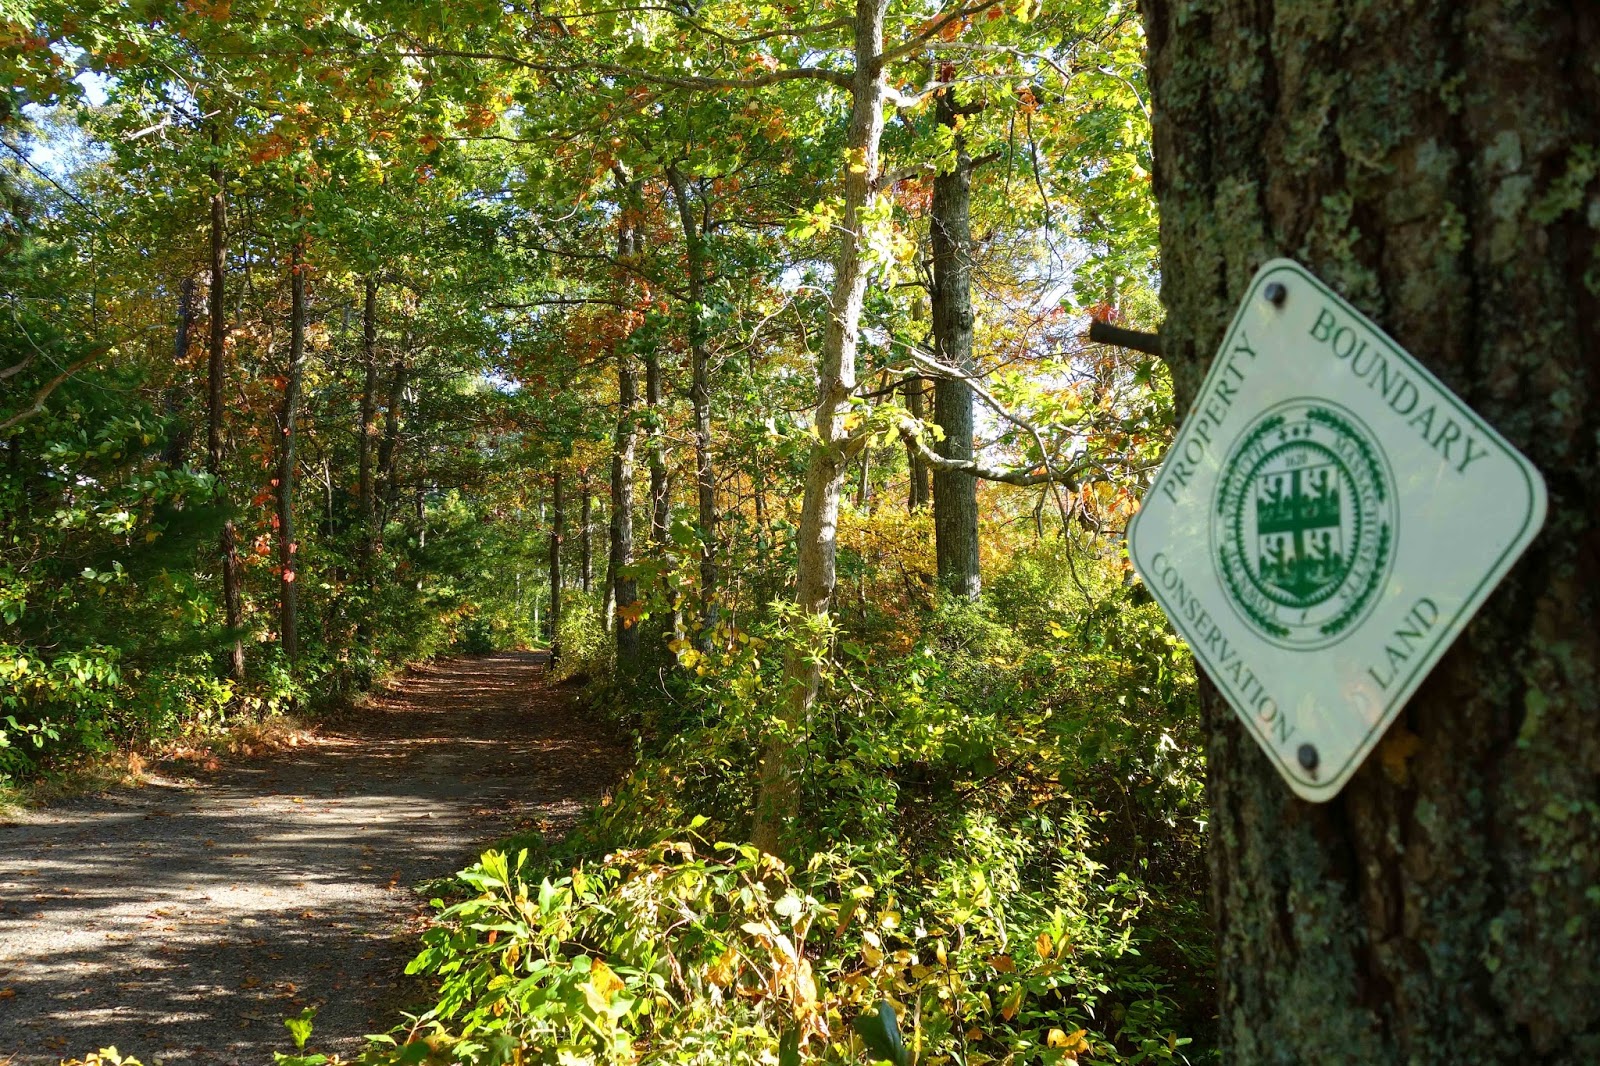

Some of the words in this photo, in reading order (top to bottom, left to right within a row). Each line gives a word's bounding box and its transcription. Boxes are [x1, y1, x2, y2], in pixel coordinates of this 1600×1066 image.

[1163, 330, 1258, 504] PROPERTY
[1285, 454, 1308, 467] 1620
[1309, 307, 1488, 474] BOUNDARY
[1335, 436, 1377, 600] MASSACHUSETTS
[1151, 552, 1296, 744] CONSERVATION
[1367, 596, 1439, 691] LAND
